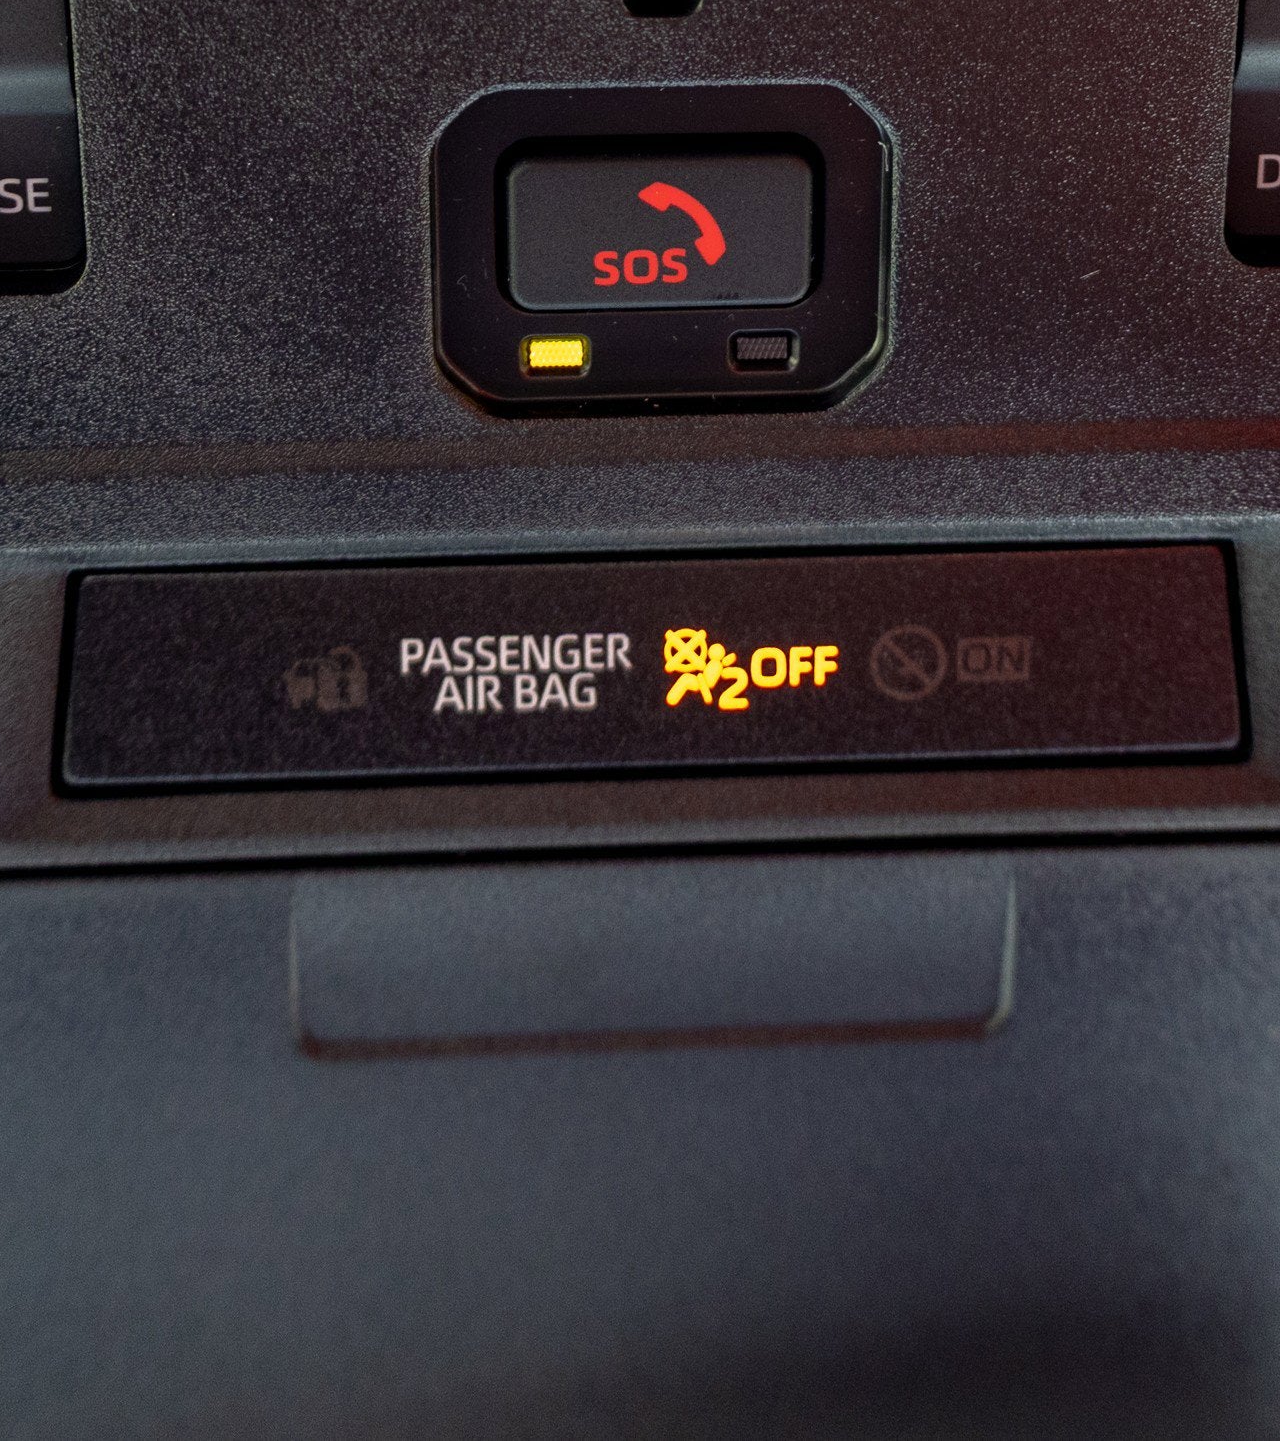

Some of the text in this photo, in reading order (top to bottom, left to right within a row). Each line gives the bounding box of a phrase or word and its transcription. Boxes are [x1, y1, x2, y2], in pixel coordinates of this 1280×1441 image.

[593, 248, 689, 286] SOS
[399, 633, 632, 675] PASSENGER
[750, 645, 839, 688] OFF
[961, 639, 1029, 679] ON
[433, 674, 597, 712] AIR BAG
